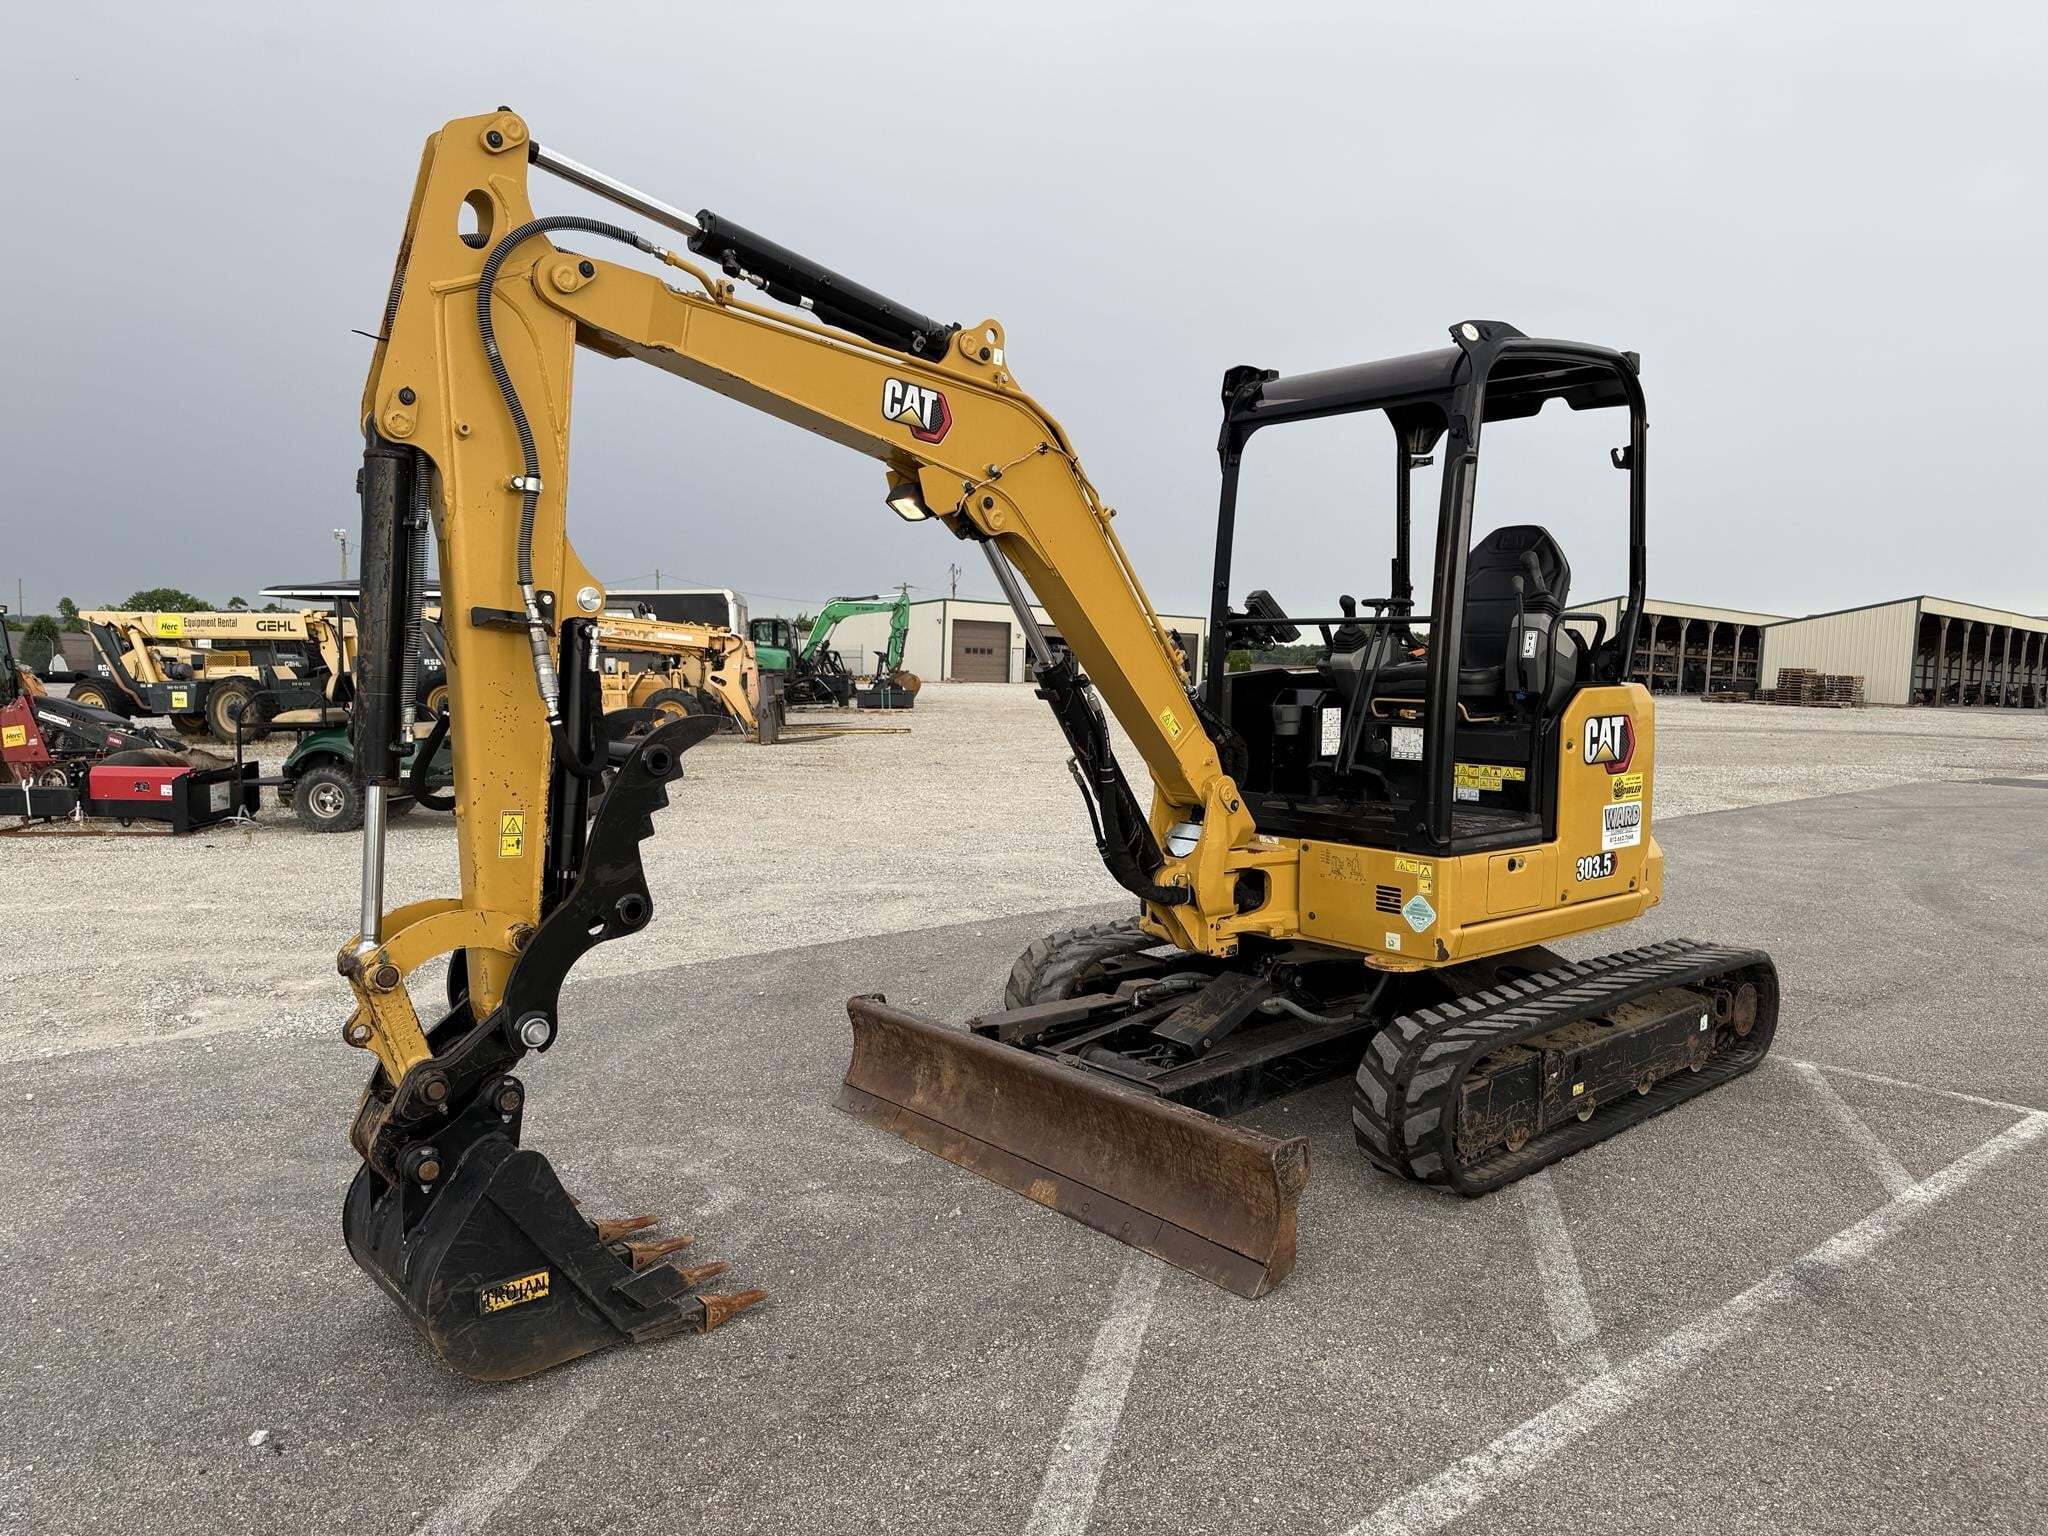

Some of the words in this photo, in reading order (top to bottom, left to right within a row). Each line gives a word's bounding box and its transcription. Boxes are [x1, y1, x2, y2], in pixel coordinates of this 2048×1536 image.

[883, 378, 938, 430] CAT
[161, 622, 178, 631] Herc
[183, 617, 217, 629] Equipment
[218, 617, 238, 628] Rental
[255, 620, 297, 632] GEHL
[1584, 715, 1625, 763] CAT
[1604, 804, 1641, 831] WARD
[1576, 852, 1612, 881] 303.5
[483, 1274, 548, 1308] TROJAN
